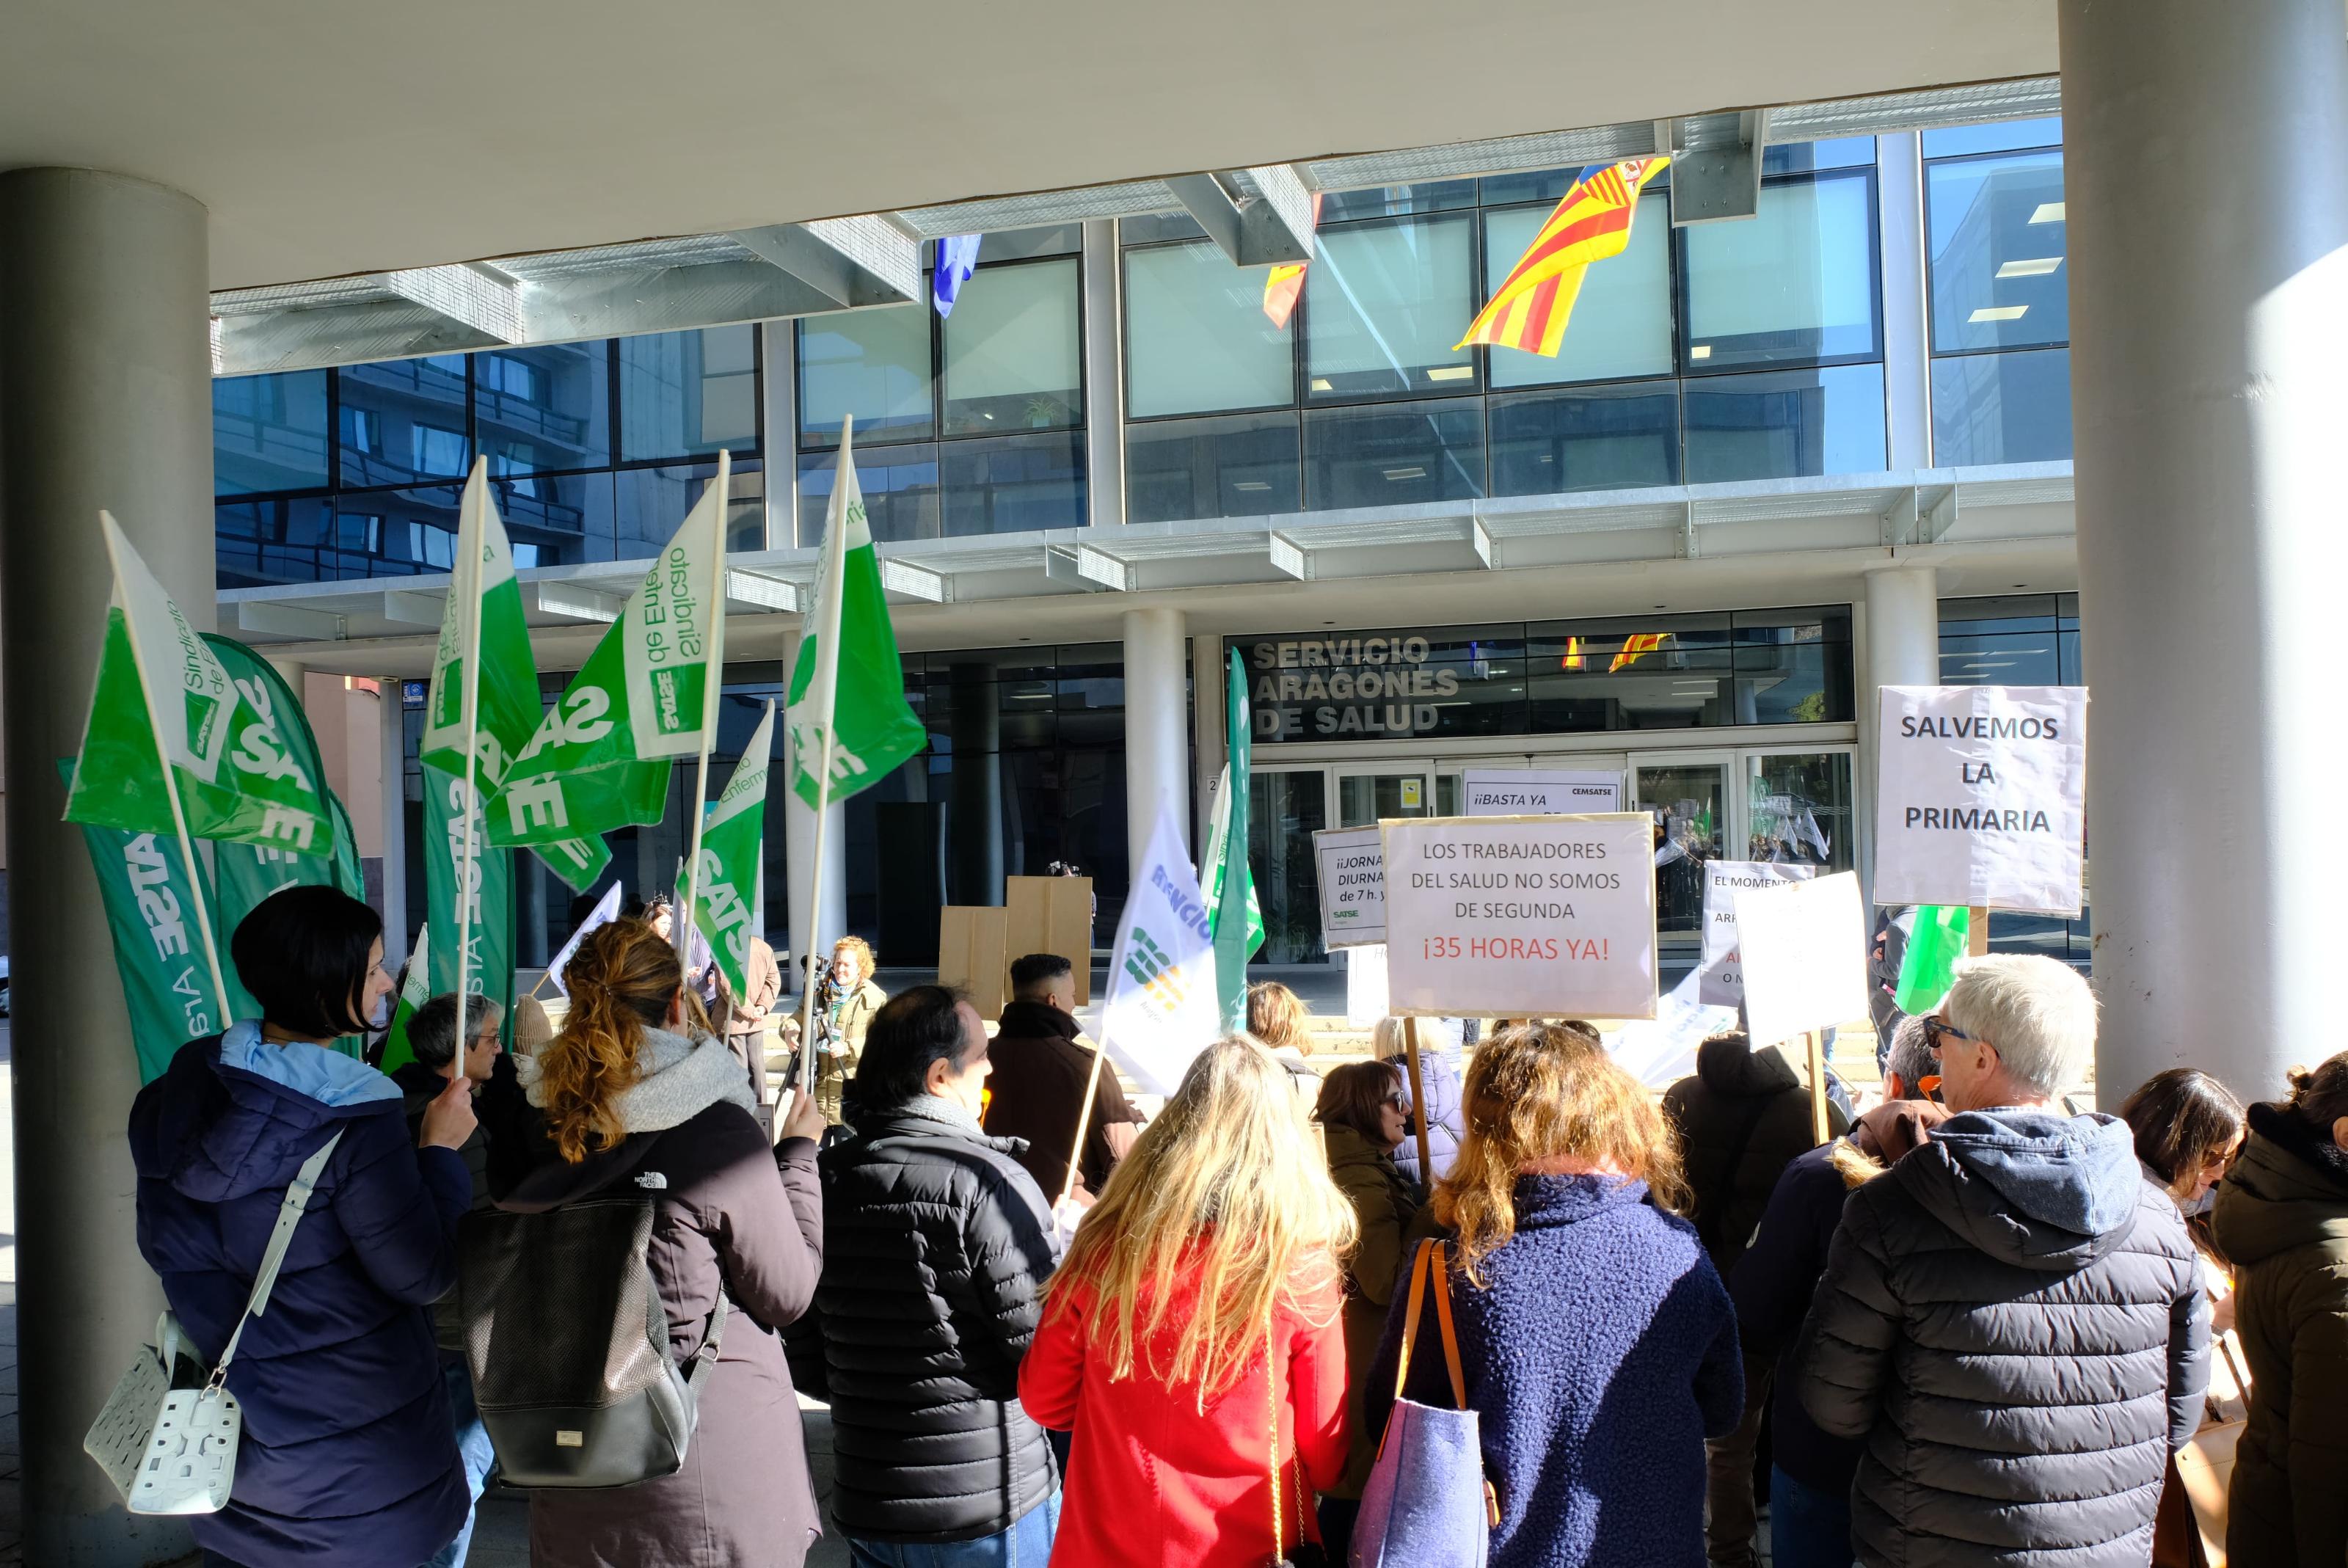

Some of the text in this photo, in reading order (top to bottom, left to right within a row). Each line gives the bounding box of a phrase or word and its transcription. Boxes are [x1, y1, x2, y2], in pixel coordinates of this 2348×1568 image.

[167, 599, 203, 690] Sindicato
[1253, 636, 1429, 669] SERVICIO
[1253, 668, 1459, 702] ARAGONES
[1255, 707, 1303, 734] DE
[1315, 704, 1439, 734] SALUD
[1901, 715, 2059, 740] SALVEMOS
[1962, 762, 1996, 784] LA
[1209, 780, 1216, 791] 2
[1572, 787, 1612, 796] CEMSATSE
[1530, 795, 1547, 806] YA
[1906, 807, 2051, 833] PRIMARIA
[1423, 843, 1607, 859] LOS TRABAJADORES
[1337, 856, 1382, 869] ¡¡JORNA
[1338, 872, 1385, 886] DIURNA
[1412, 872, 1621, 889] DEL SALUD NO SOMOS
[1715, 876, 1727, 886] EL
[1340, 891, 1355, 902] de
[1357, 889, 1364, 901] 7
[1367, 889, 1377, 900] h.
[686, 847, 753, 968] SATS
[1333, 910, 1359, 919] SATSE
[1456, 902, 1576, 919] DE SEGUNDA
[1423, 936, 1608, 960] ¡35 HORAS YA!
